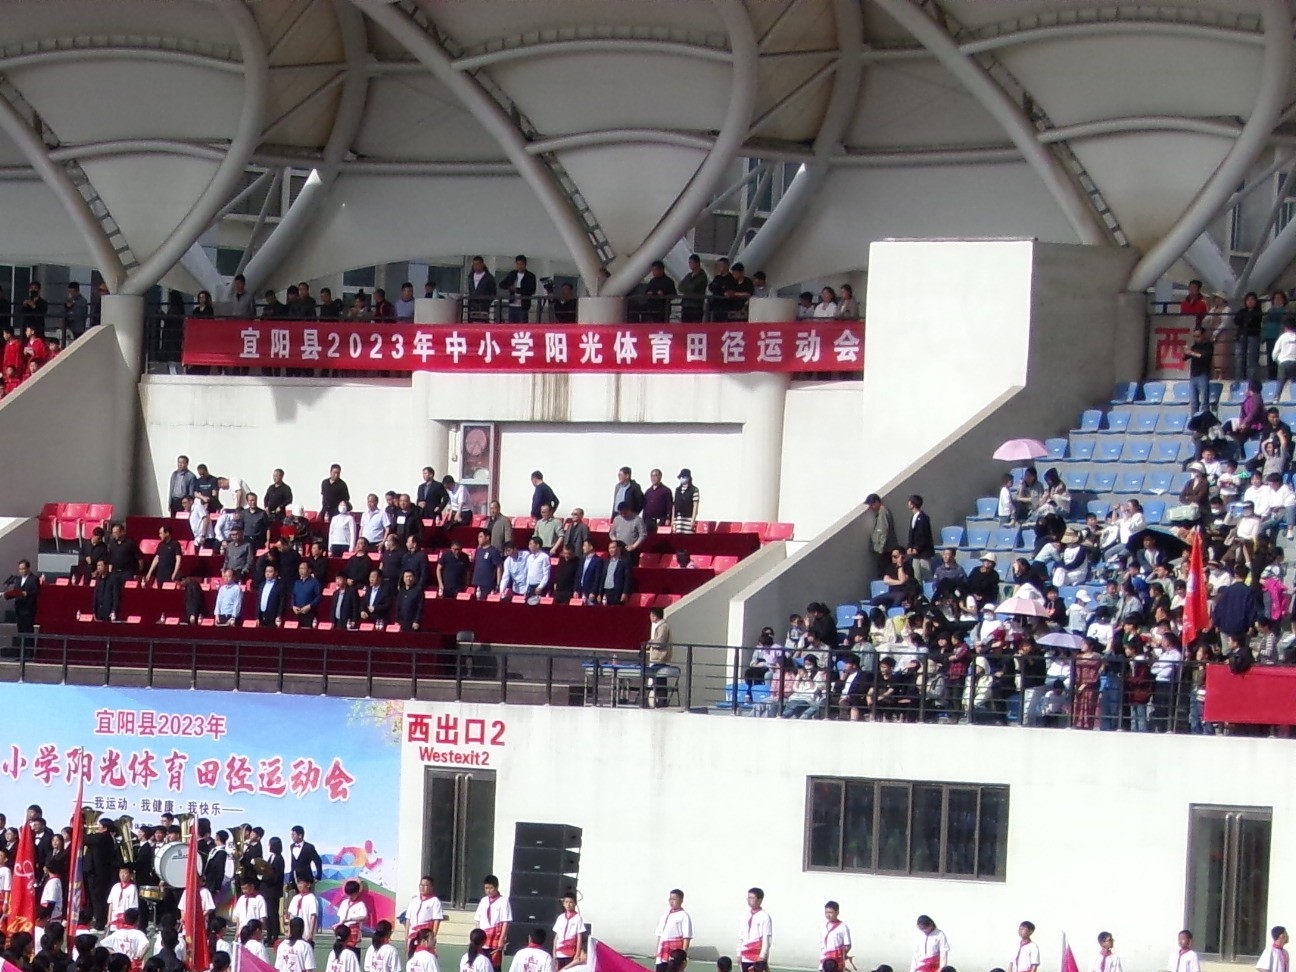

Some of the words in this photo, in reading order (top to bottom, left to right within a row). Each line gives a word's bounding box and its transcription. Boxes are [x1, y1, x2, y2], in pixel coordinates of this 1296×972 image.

[239, 328, 860, 364] 宜阳县2023年中小学阳光体育田径运动会
[1155, 328, 1190, 371] 西
[95, 709, 227, 740] 宜阳县2023年
[407, 714, 505, 746] 西出口2
[419, 746, 489, 765] Westexit2
